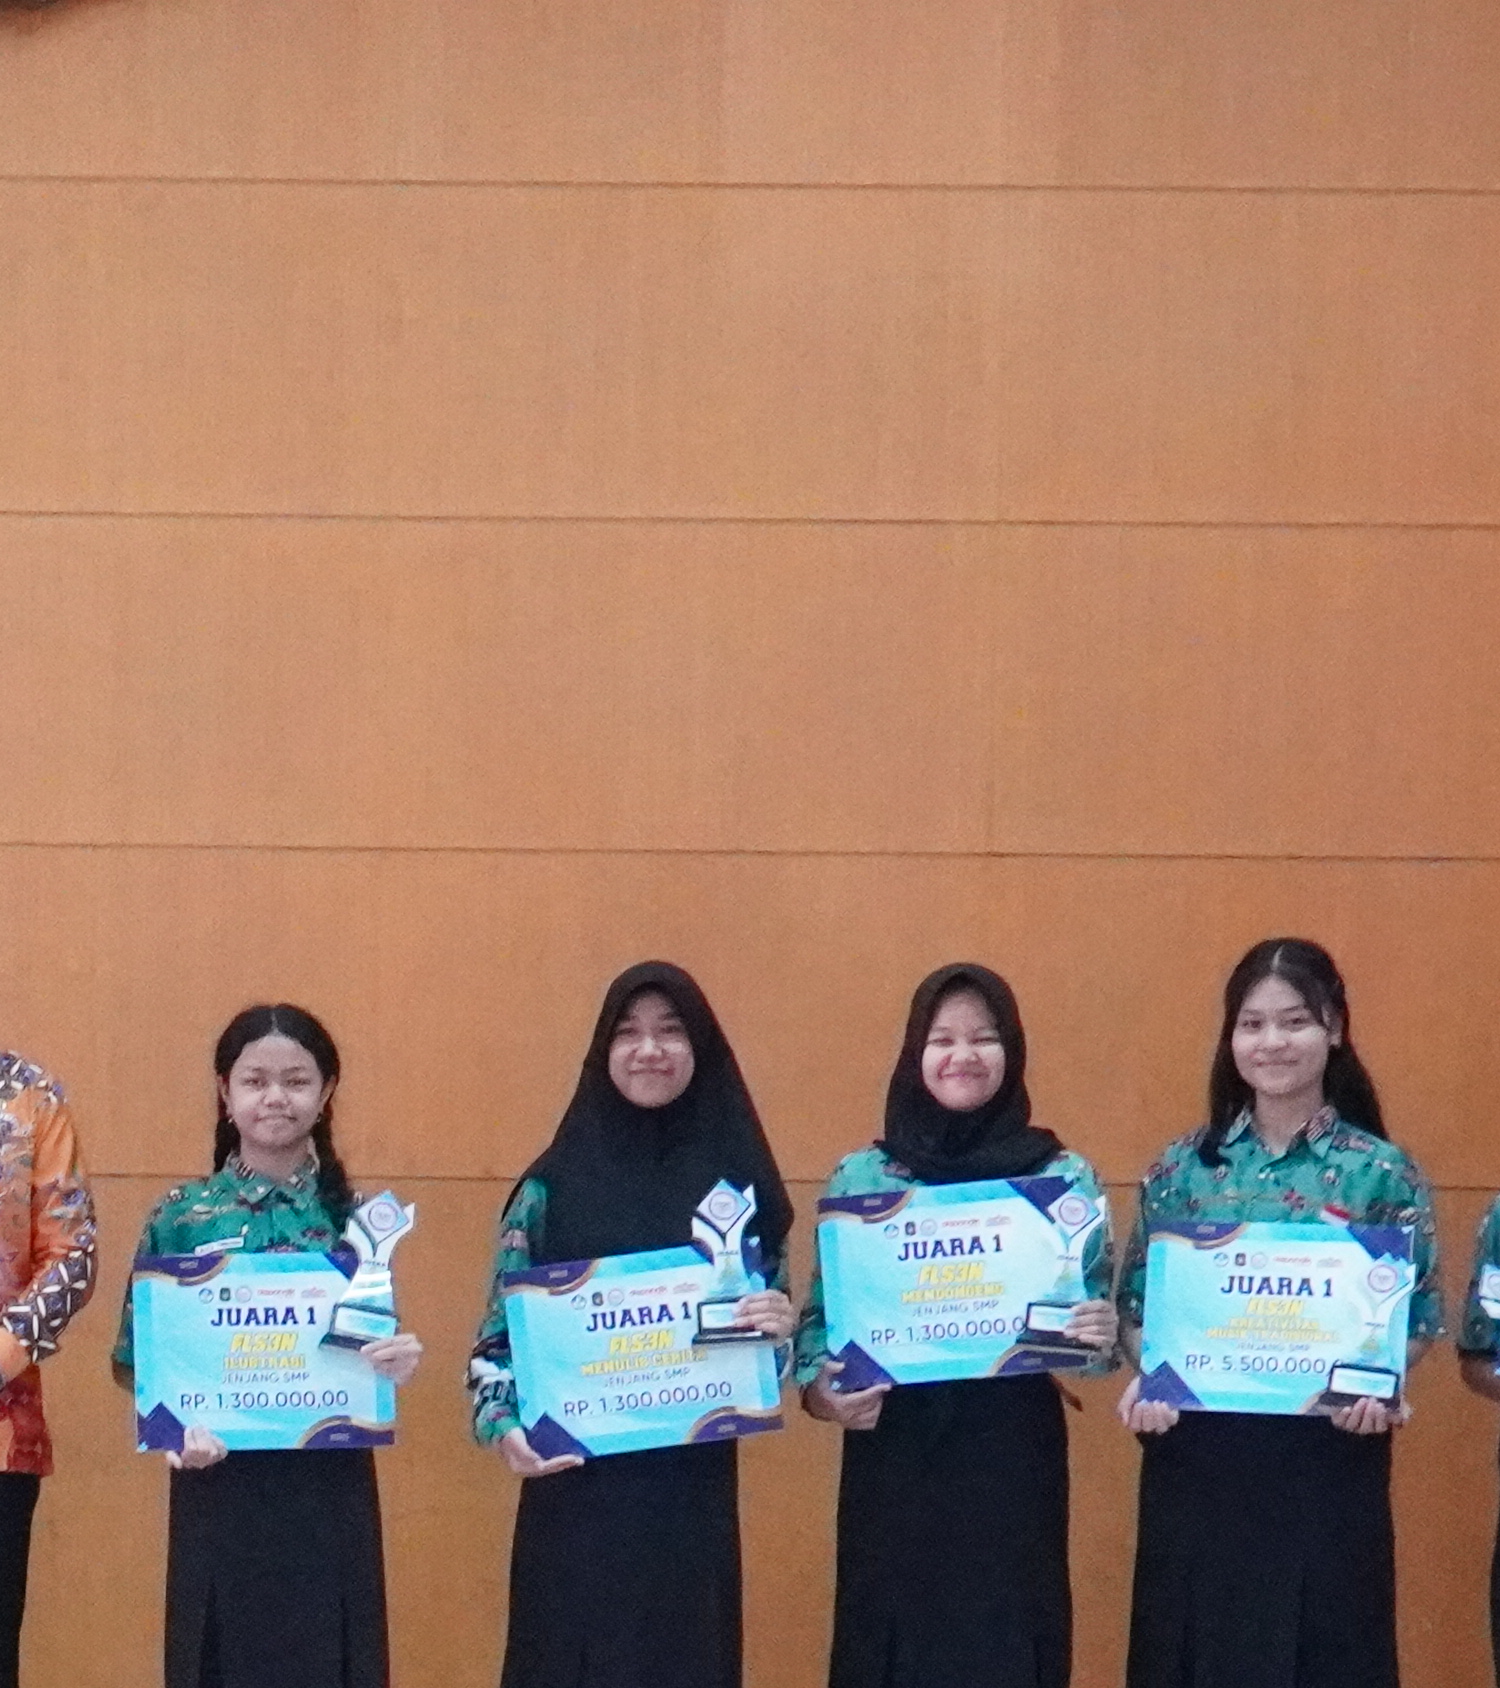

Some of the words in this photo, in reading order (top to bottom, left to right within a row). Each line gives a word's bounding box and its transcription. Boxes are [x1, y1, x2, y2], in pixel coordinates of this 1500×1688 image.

[897, 1236, 985, 1261] JUARA
[992, 1234, 1003, 1253] 1
[1220, 1275, 1315, 1297] JUARA
[1323, 1278, 1333, 1297] 1
[210, 1307, 299, 1327] JUARA
[306, 1306, 317, 1325] 1
[586, 1303, 675, 1332] JUARA
[681, 1301, 692, 1320] 1
[871, 1329, 900, 1345] RP.
[905, 1316, 1027, 1342] 1.300.000,0
[1185, 1354, 1214, 1371] RP.
[220, 1371, 280, 1384] JENJANG
[283, 1371, 311, 1384] SMP
[603, 1371, 661, 1388] JENJANG
[664, 1366, 691, 1379] SMP
[180, 1393, 210, 1410] RP.
[216, 1390, 349, 1410] 1.300.000,00
[563, 1399, 594, 1417] RP.
[598, 1381, 732, 1413] 1.300.000,00
